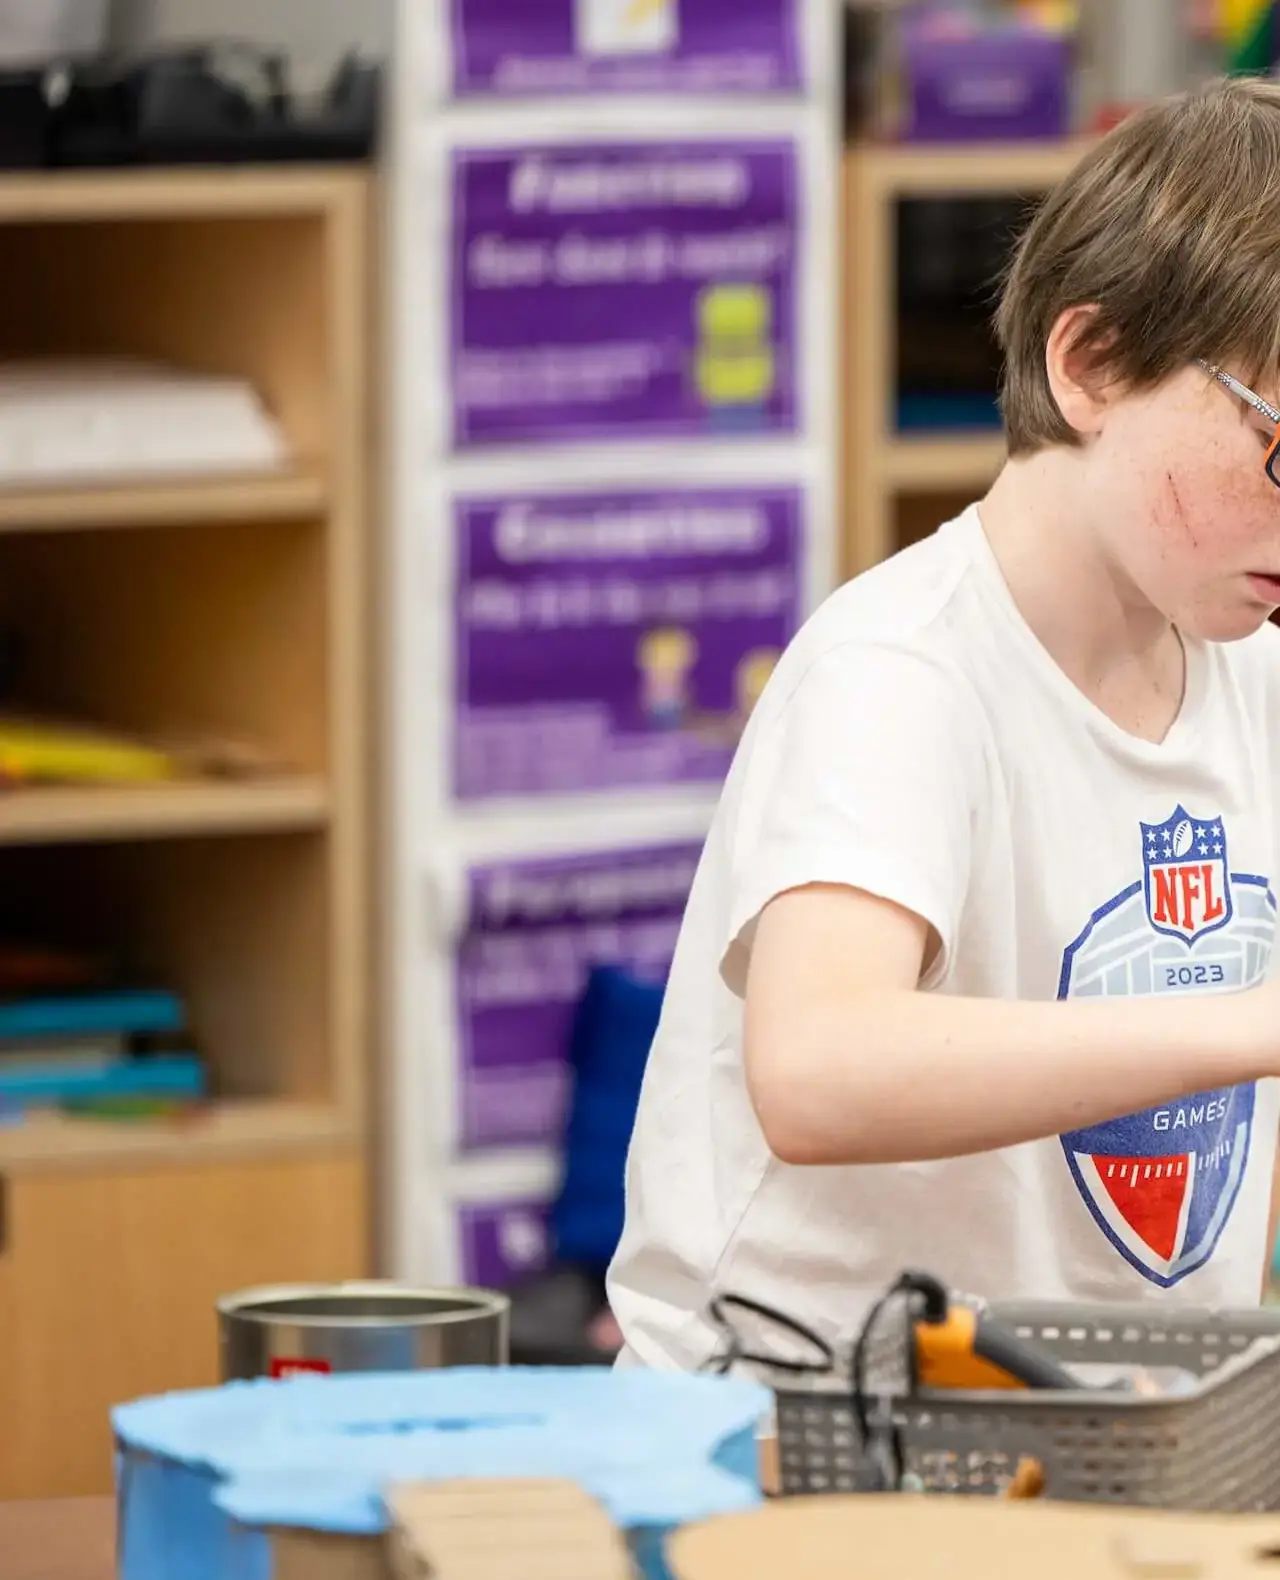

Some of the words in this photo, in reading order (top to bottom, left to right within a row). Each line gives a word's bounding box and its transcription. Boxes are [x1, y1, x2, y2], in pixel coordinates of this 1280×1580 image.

[1152, 864, 1223, 930] NFL
[1166, 964, 1224, 986] 2023
[1153, 1097, 1226, 1131] GAMES
